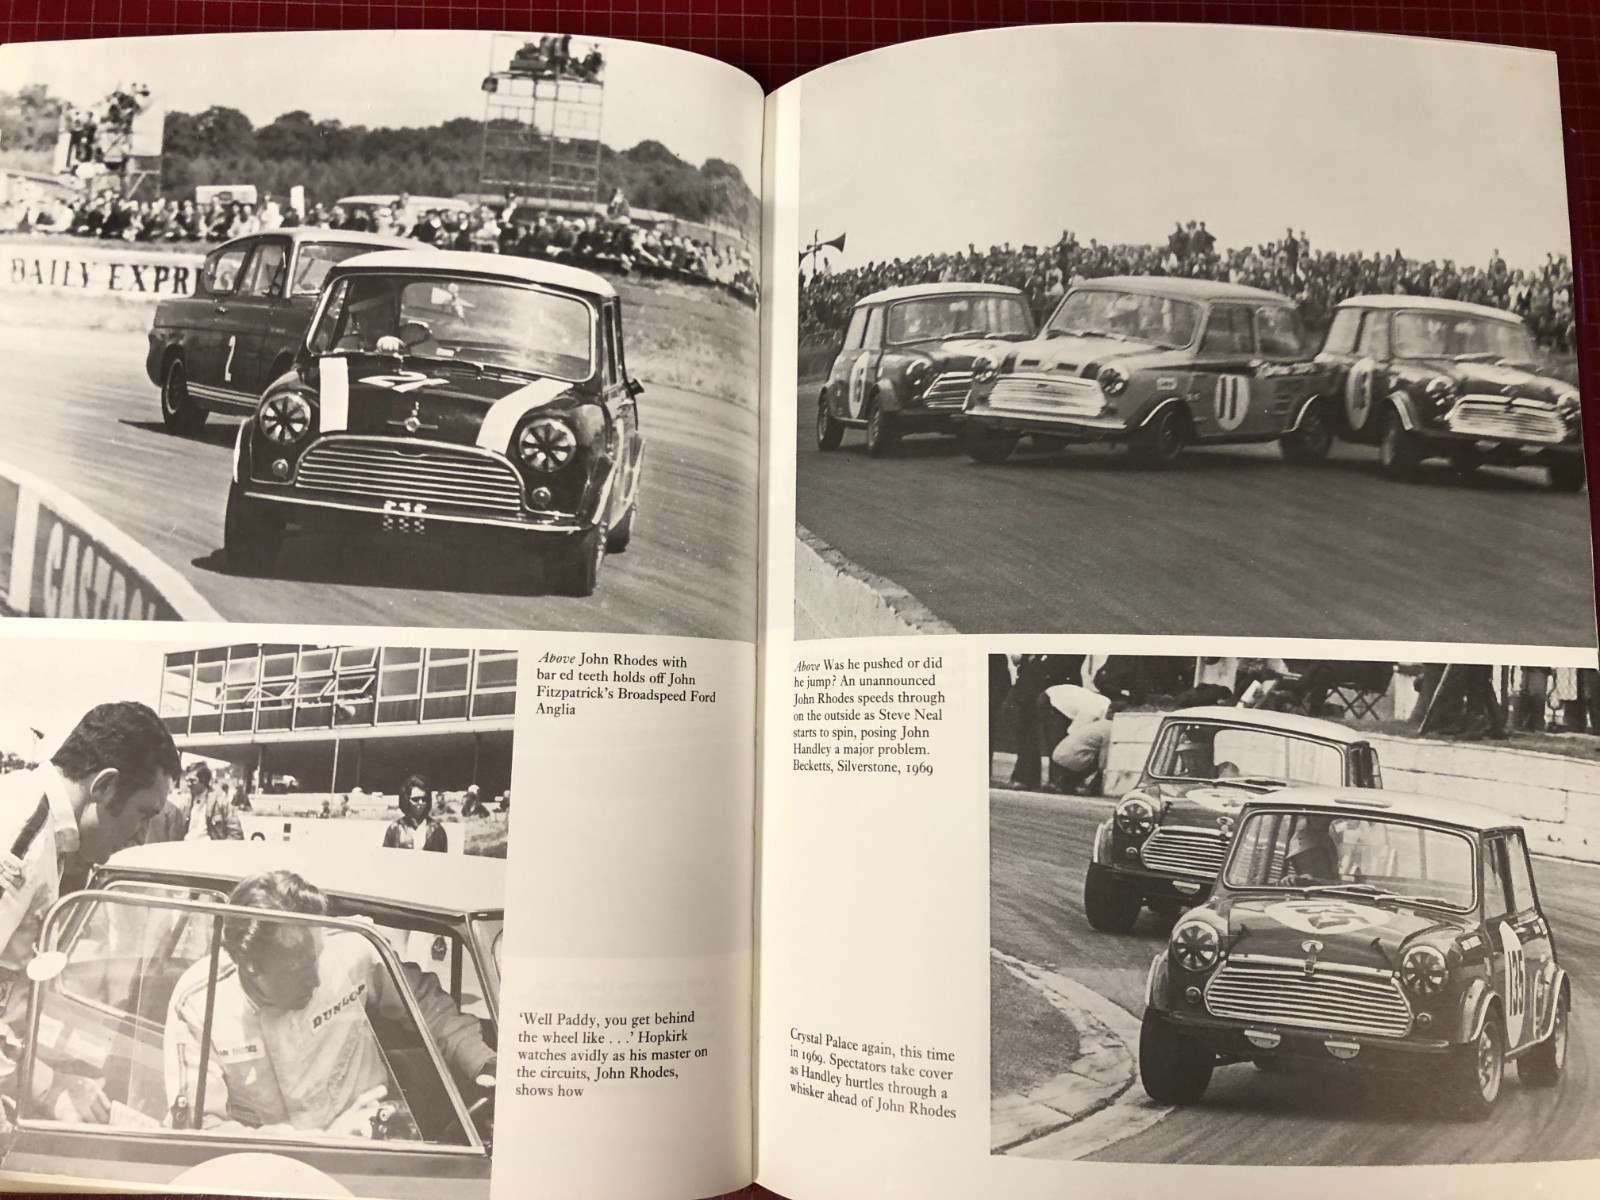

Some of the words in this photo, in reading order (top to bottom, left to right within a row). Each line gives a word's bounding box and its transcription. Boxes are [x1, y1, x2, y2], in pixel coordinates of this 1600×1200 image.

[11, 257, 98, 288] DAILY
[108, 262, 204, 294] EXPR
[1218, 376, 1238, 421] 11
[538, 651, 576, 665] Above
[578, 652, 609, 667] John
[613, 653, 658, 667] Rhodes
[662, 655, 688, 668] with
[794, 660, 821, 672] Above
[823, 659, 844, 671] Was
[847, 658, 860, 670] he
[863, 657, 903, 672] pushed
[907, 659, 920, 668] or
[923, 657, 942, 669] did
[578, 670, 609, 682] teeth
[613, 670, 645, 683] holds
[649, 672, 667, 684] off
[667, 672, 696, 687] John
[794, 676, 804, 687] he
[806, 674, 837, 690] jump?
[840, 674, 855, 686] An
[859, 674, 936, 686] unannounced
[618, 687, 687, 704] Broadspeed
[689, 690, 716, 703] Ford
[793, 693, 815, 707] John
[817, 692, 855, 704] Rhodes
[857, 692, 894, 706] speeds
[897, 691, 945, 706] through
[536, 702, 576, 718] Anglia
[793, 712, 804, 721] on
[807, 710, 822, 721] the
[824, 709, 861, 721] outside
[864, 711, 875, 721] as
[879, 708, 910, 721] Steve
[914, 708, 942, 721] Neal
[793, 728, 817, 738] starts
[820, 728, 829, 737] to
[832, 726, 857, 740] spin,
[860, 726, 897, 740] posing
[900, 725, 930, 740] John
[793, 743, 832, 757] Handley
[834, 745, 840, 755] a
[843, 743, 874, 757] major
[877, 743, 930, 757] problem.
[792, 759, 834, 773] Becketts,
[837, 760, 901, 775] Silverstone,
[906, 761, 934, 776] 1969
[1507, 949, 1524, 1017] 135
[313, 984, 366, 1029] DUNLOP
[556, 1013, 600, 1028] Paddy,
[604, 1015, 627, 1029] you
[631, 1015, 650, 1030] get
[654, 1010, 695, 1025] behind
[518, 1032, 538, 1043] the
[542, 1032, 578, 1044] wheel
[582, 1031, 605, 1044] like
[638, 1029, 688, 1046] Hopkirk
[790, 1027, 823, 1046] Crystal
[825, 1033, 859, 1051] Palace
[861, 1042, 896, 1058] again,
[900, 1045, 923, 1059] this
[927, 1047, 955, 1061] time
[518, 1049, 567, 1061] watches
[570, 1049, 609, 1064] avidly
[612, 1051, 625, 1061] as
[629, 1049, 647, 1061] his
[651, 1048, 691, 1061] master
[694, 1048, 708, 1058] on
[790, 1045, 799, 1057] in
[801, 1050, 826, 1066] 1969.
[829, 1052, 887, 1073] Spectators
[890, 1063, 915, 1077] take
[919, 1069, 953, 1080] cover
[516, 1066, 536, 1078] the
[540, 1067, 591, 1081] circuits,
[594, 1067, 625, 1082] John
[629, 1066, 679, 1079] Rhodes,
[789, 1066, 799, 1075] as
[801, 1064, 842, 1087] Handley
[845, 1074, 884, 1092] hurtles
[888, 1080, 937, 1100] through
[941, 1089, 948, 1099] a
[515, 1084, 553, 1097] shows
[557, 1084, 584, 1097] how
[790, 1082, 825, 1100] whisker
[827, 1090, 857, 1106] ahead
[861, 1096, 874, 1108] of
[875, 1097, 905, 1113] John
[909, 1101, 957, 1119] Rhodes
